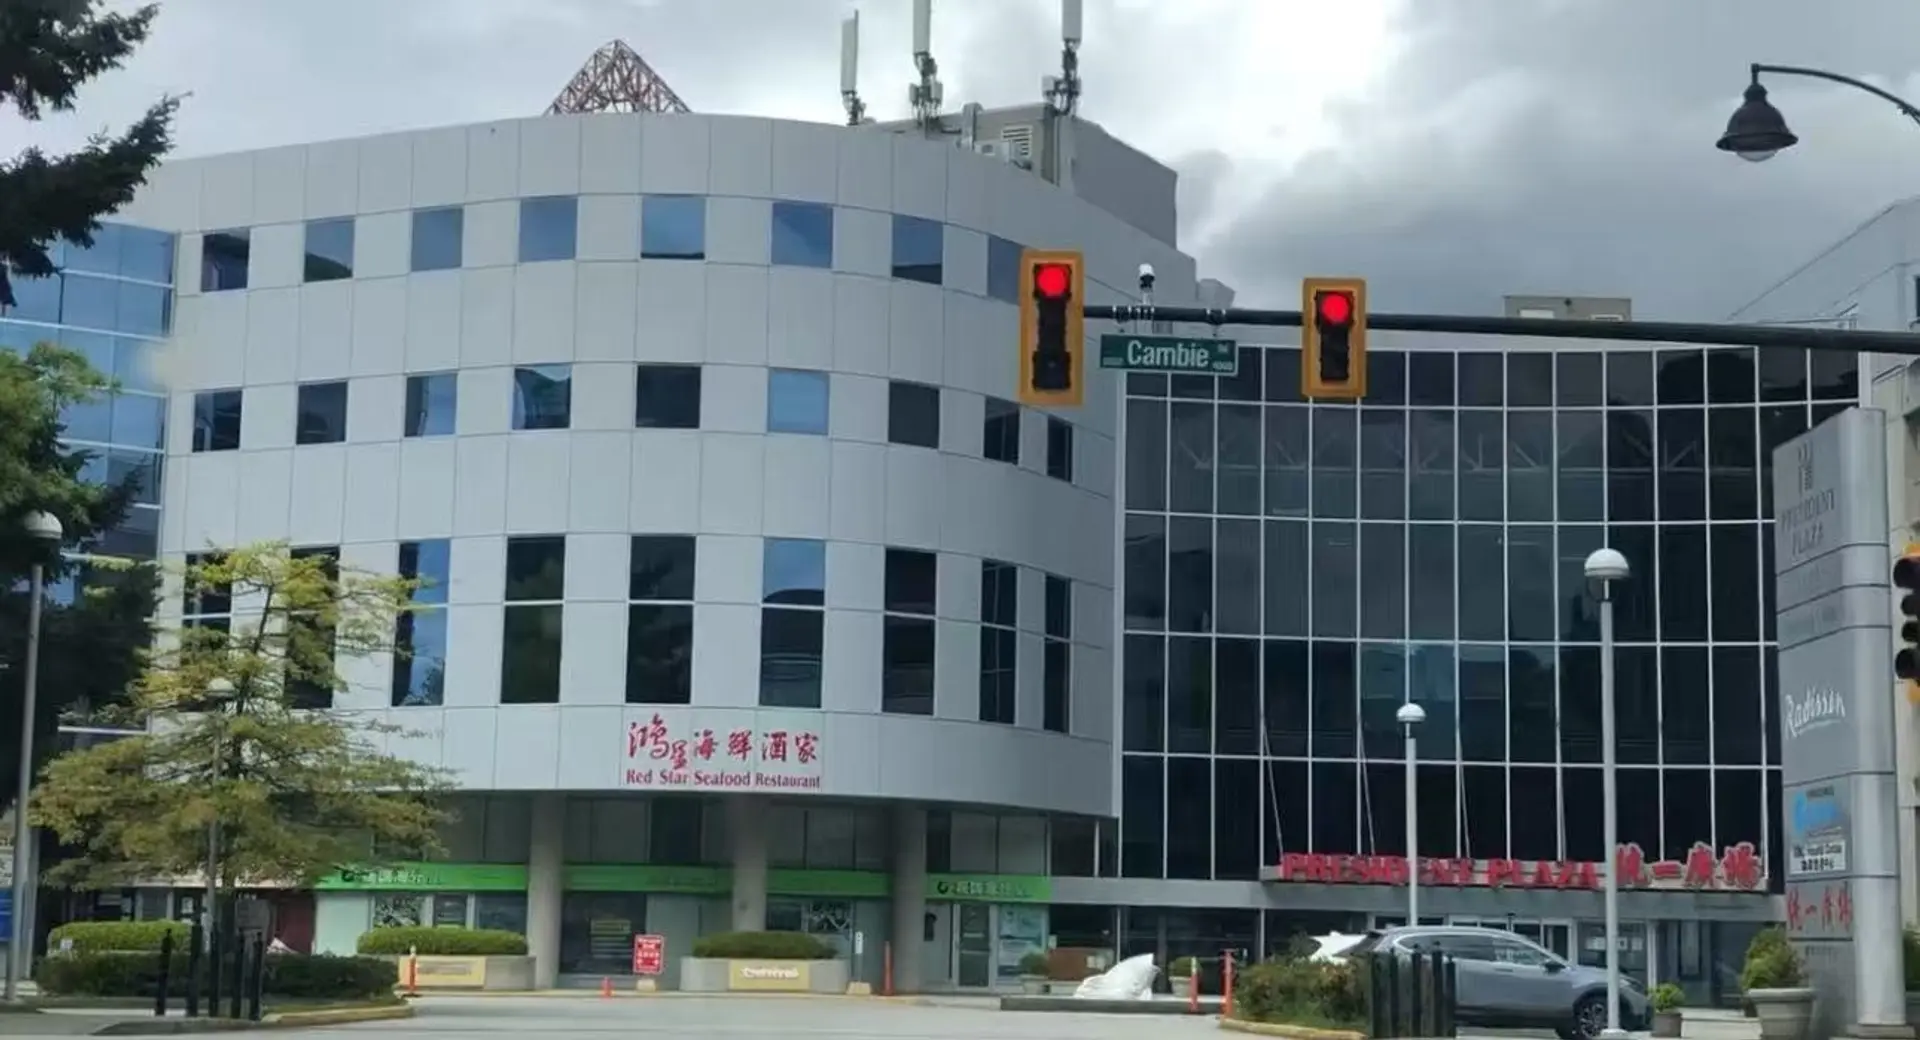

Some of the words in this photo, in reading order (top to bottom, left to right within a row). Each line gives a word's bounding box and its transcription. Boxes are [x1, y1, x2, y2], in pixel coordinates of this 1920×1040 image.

[1127, 340, 1209, 367] Cambie
[1784, 686, 1846, 739] Radisson
[626, 769, 653, 784] Red
[659, 770, 688, 785] Star
[694, 771, 750, 787] Seafood
[755, 772, 821, 789] Restaurant
[1486, 857, 1599, 886] PLAZA
